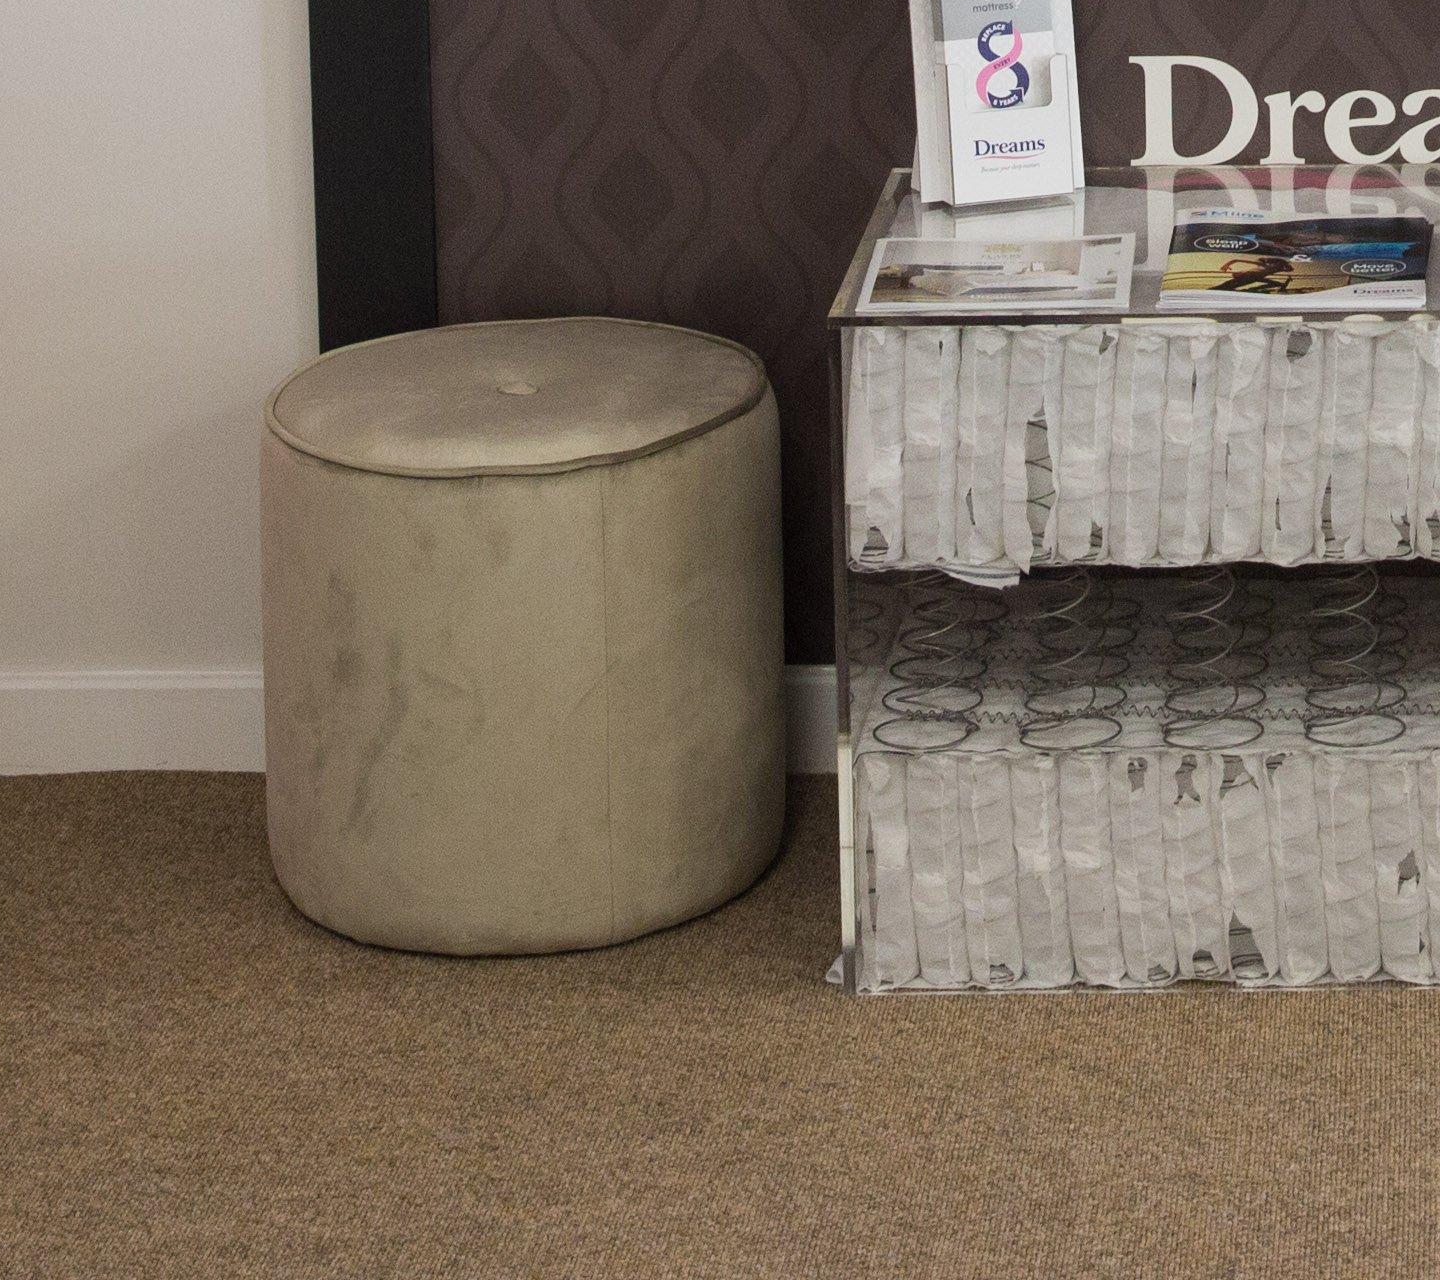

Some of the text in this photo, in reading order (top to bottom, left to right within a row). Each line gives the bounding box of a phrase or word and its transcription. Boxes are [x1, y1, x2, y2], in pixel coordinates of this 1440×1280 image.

[980, 22, 1007, 43] REPLACE
[998, 94, 1019, 107] YEARS
[974, 138, 1046, 157] Dreams
